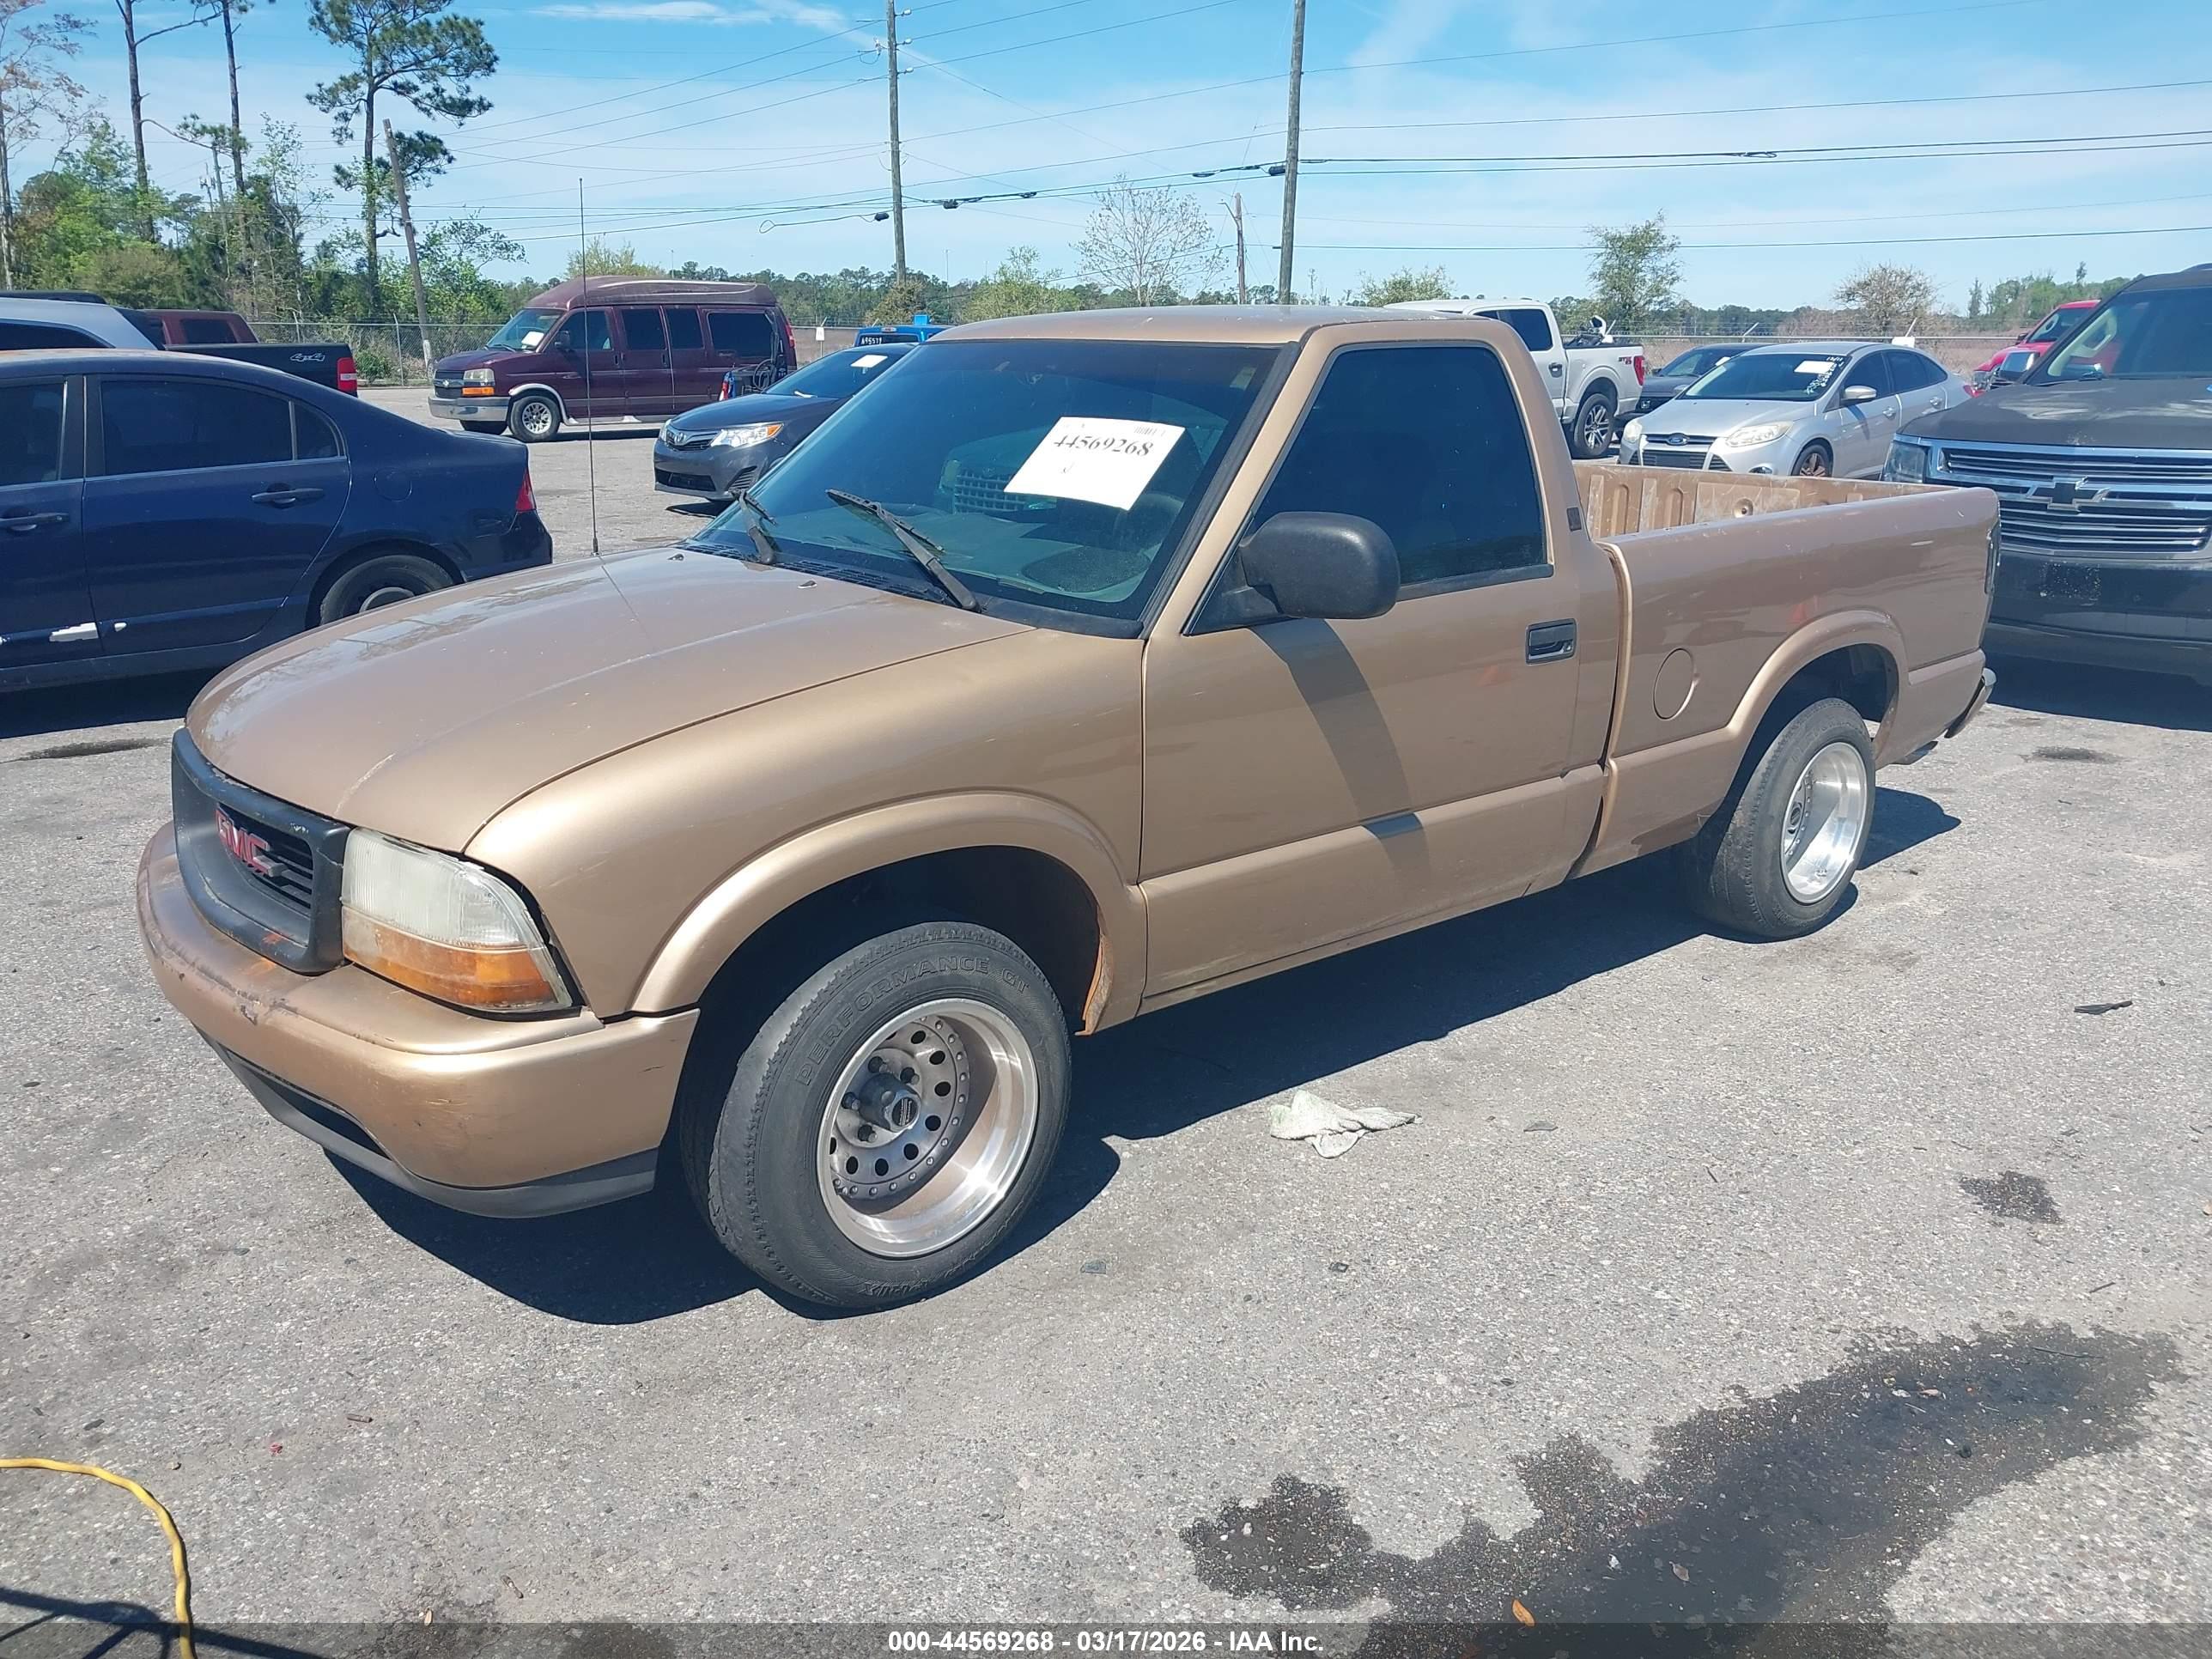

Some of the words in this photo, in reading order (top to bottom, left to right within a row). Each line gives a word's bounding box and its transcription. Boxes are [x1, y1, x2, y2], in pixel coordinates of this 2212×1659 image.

[1053, 434, 1154, 457] 44569268
[215, 807, 274, 877] GMC
[794, 955, 990, 1087] PERFORMANCE
[1001, 967, 1030, 994] GT
